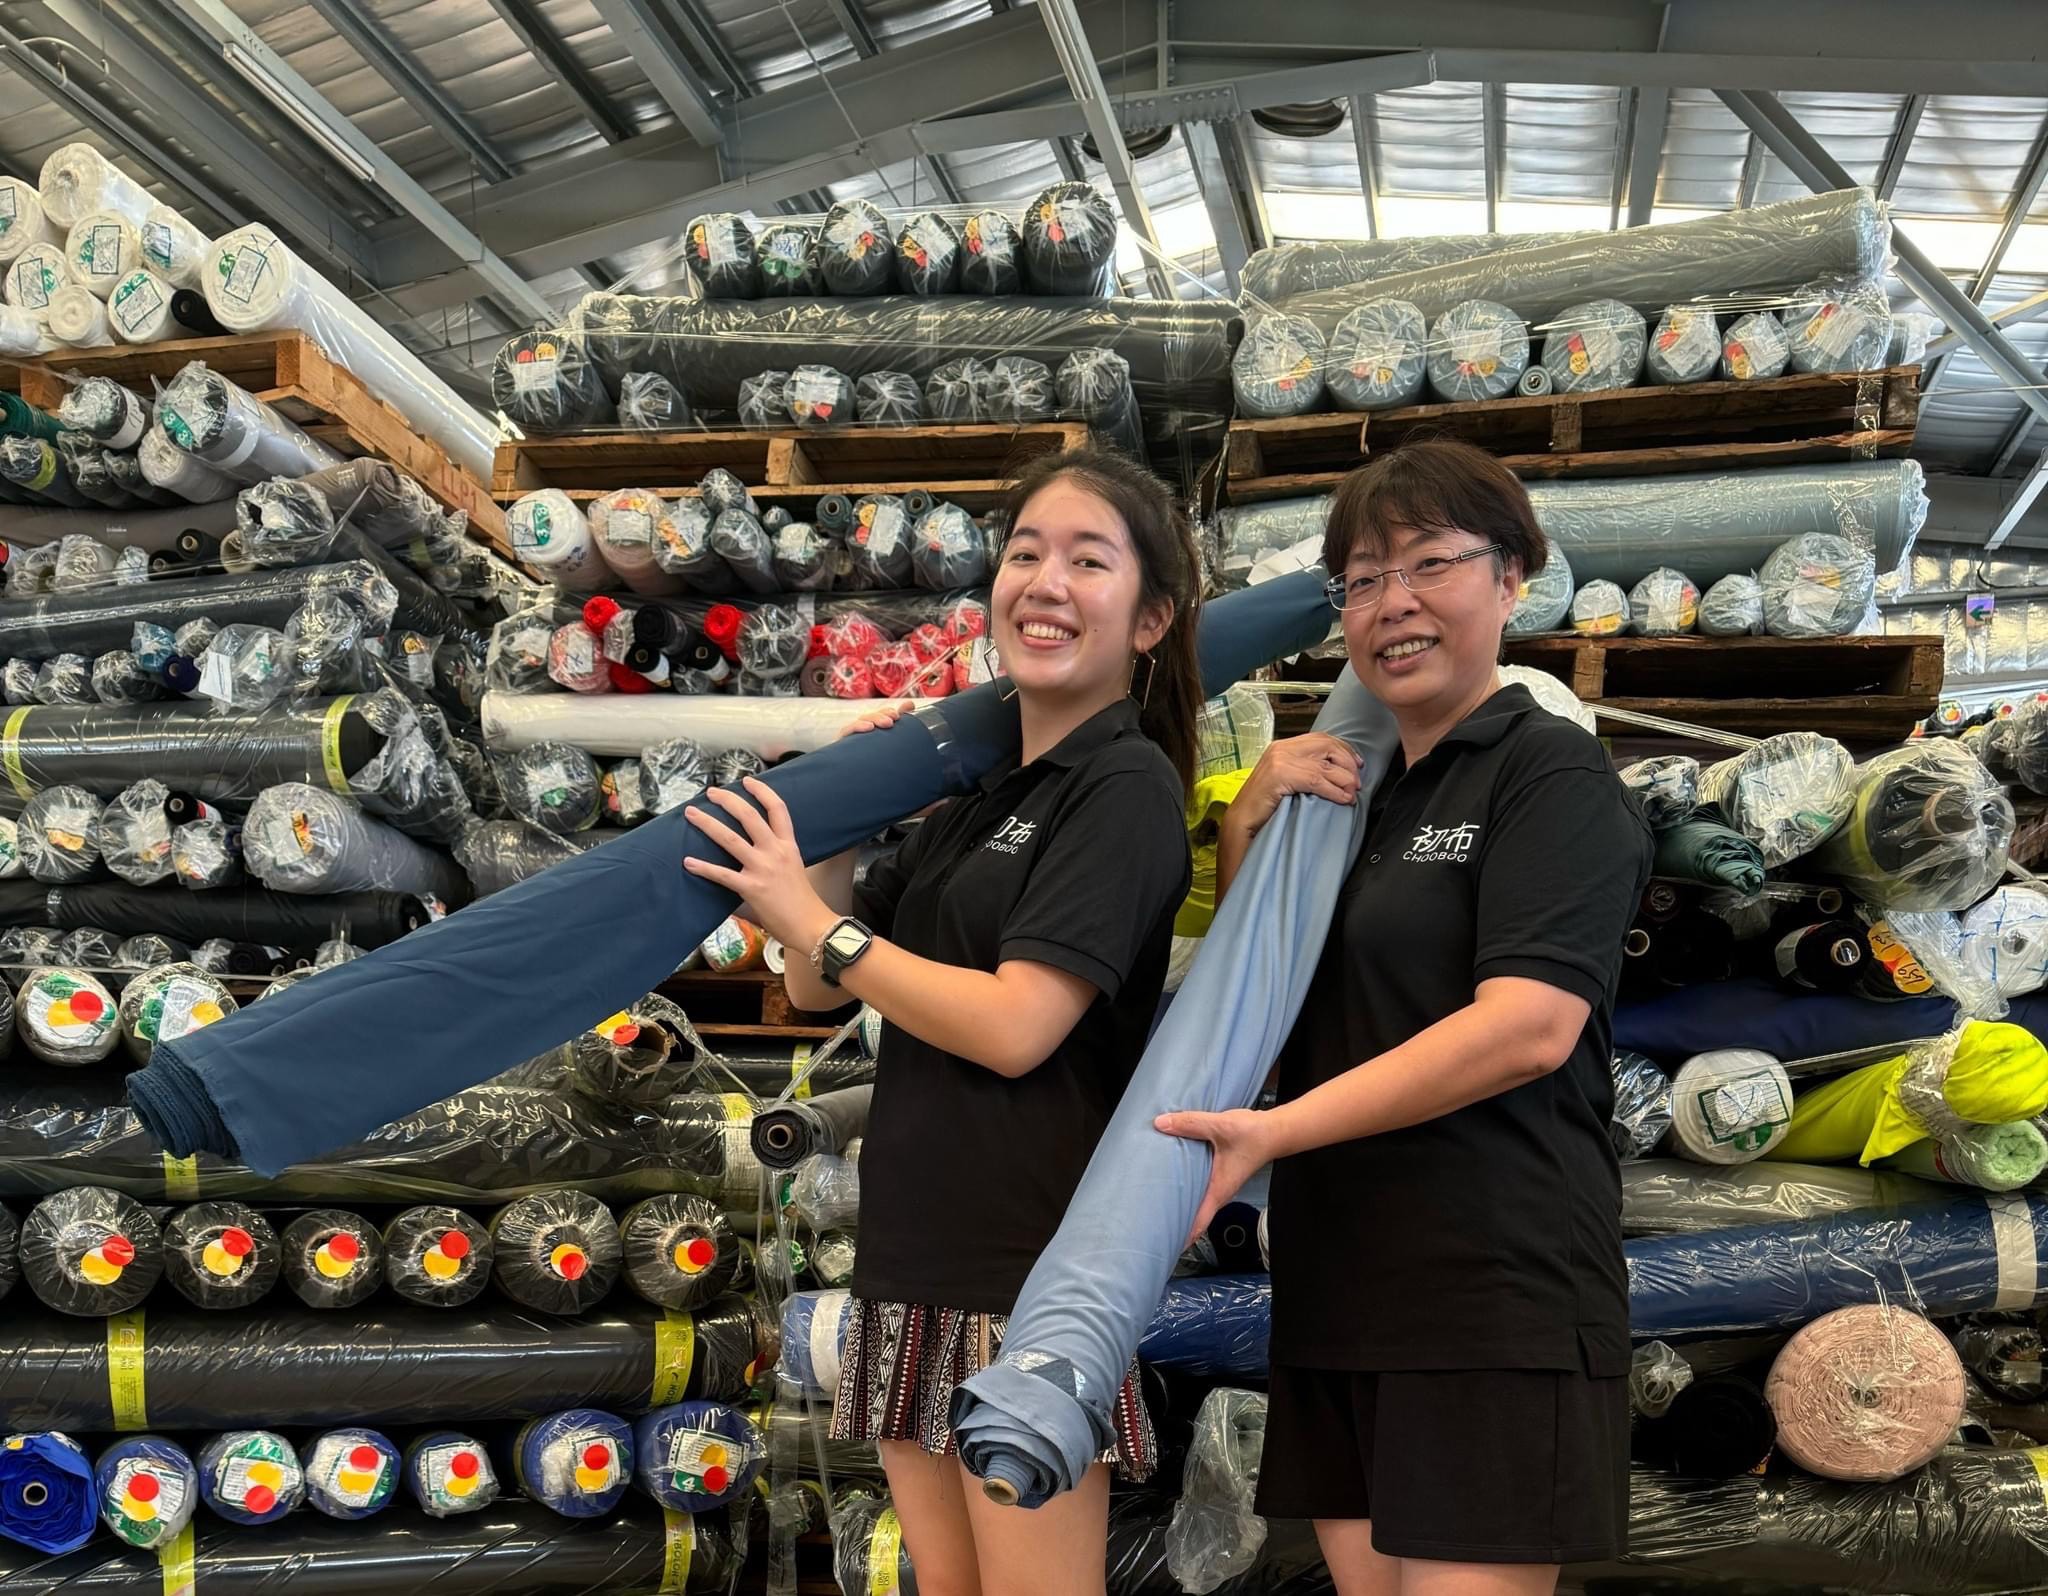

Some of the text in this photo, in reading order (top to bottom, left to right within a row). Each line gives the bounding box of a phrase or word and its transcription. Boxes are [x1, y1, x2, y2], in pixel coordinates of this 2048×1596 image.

[1412, 821, 1480, 853] 初布
[1402, 850, 1468, 863] CHOOBOO
[682, 1476, 696, 1490] 4
